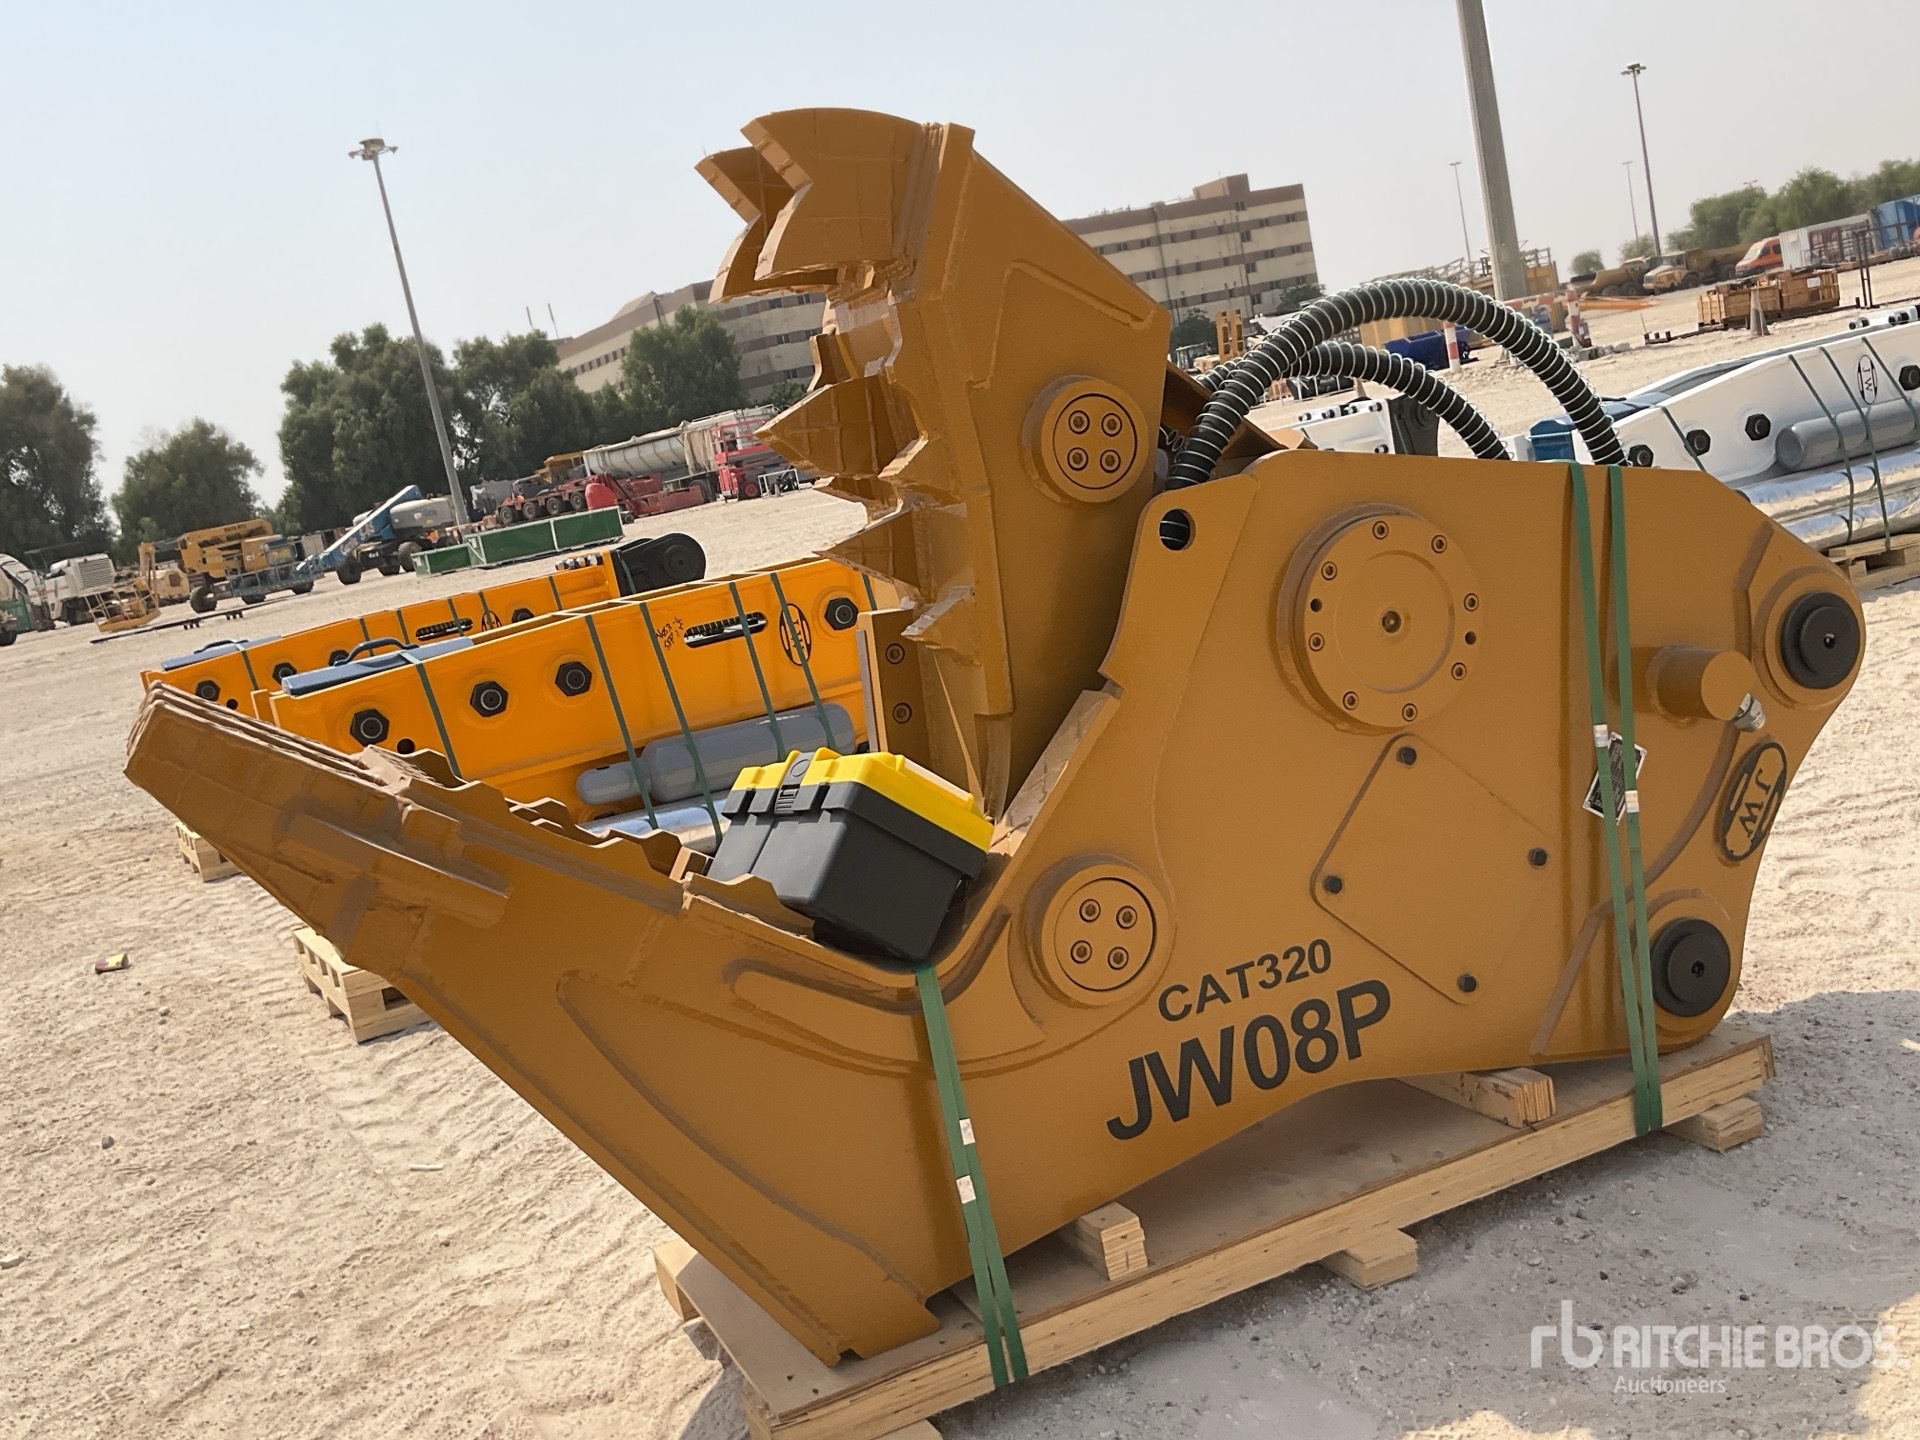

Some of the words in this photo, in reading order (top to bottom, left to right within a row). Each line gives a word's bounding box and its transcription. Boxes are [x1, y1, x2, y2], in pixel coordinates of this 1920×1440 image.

[1862, 367, 1873, 391] JW
[1739, 768, 1771, 838] JW
[1159, 938, 1332, 1021] CAT320
[1106, 979, 1391, 1140] JW08P
